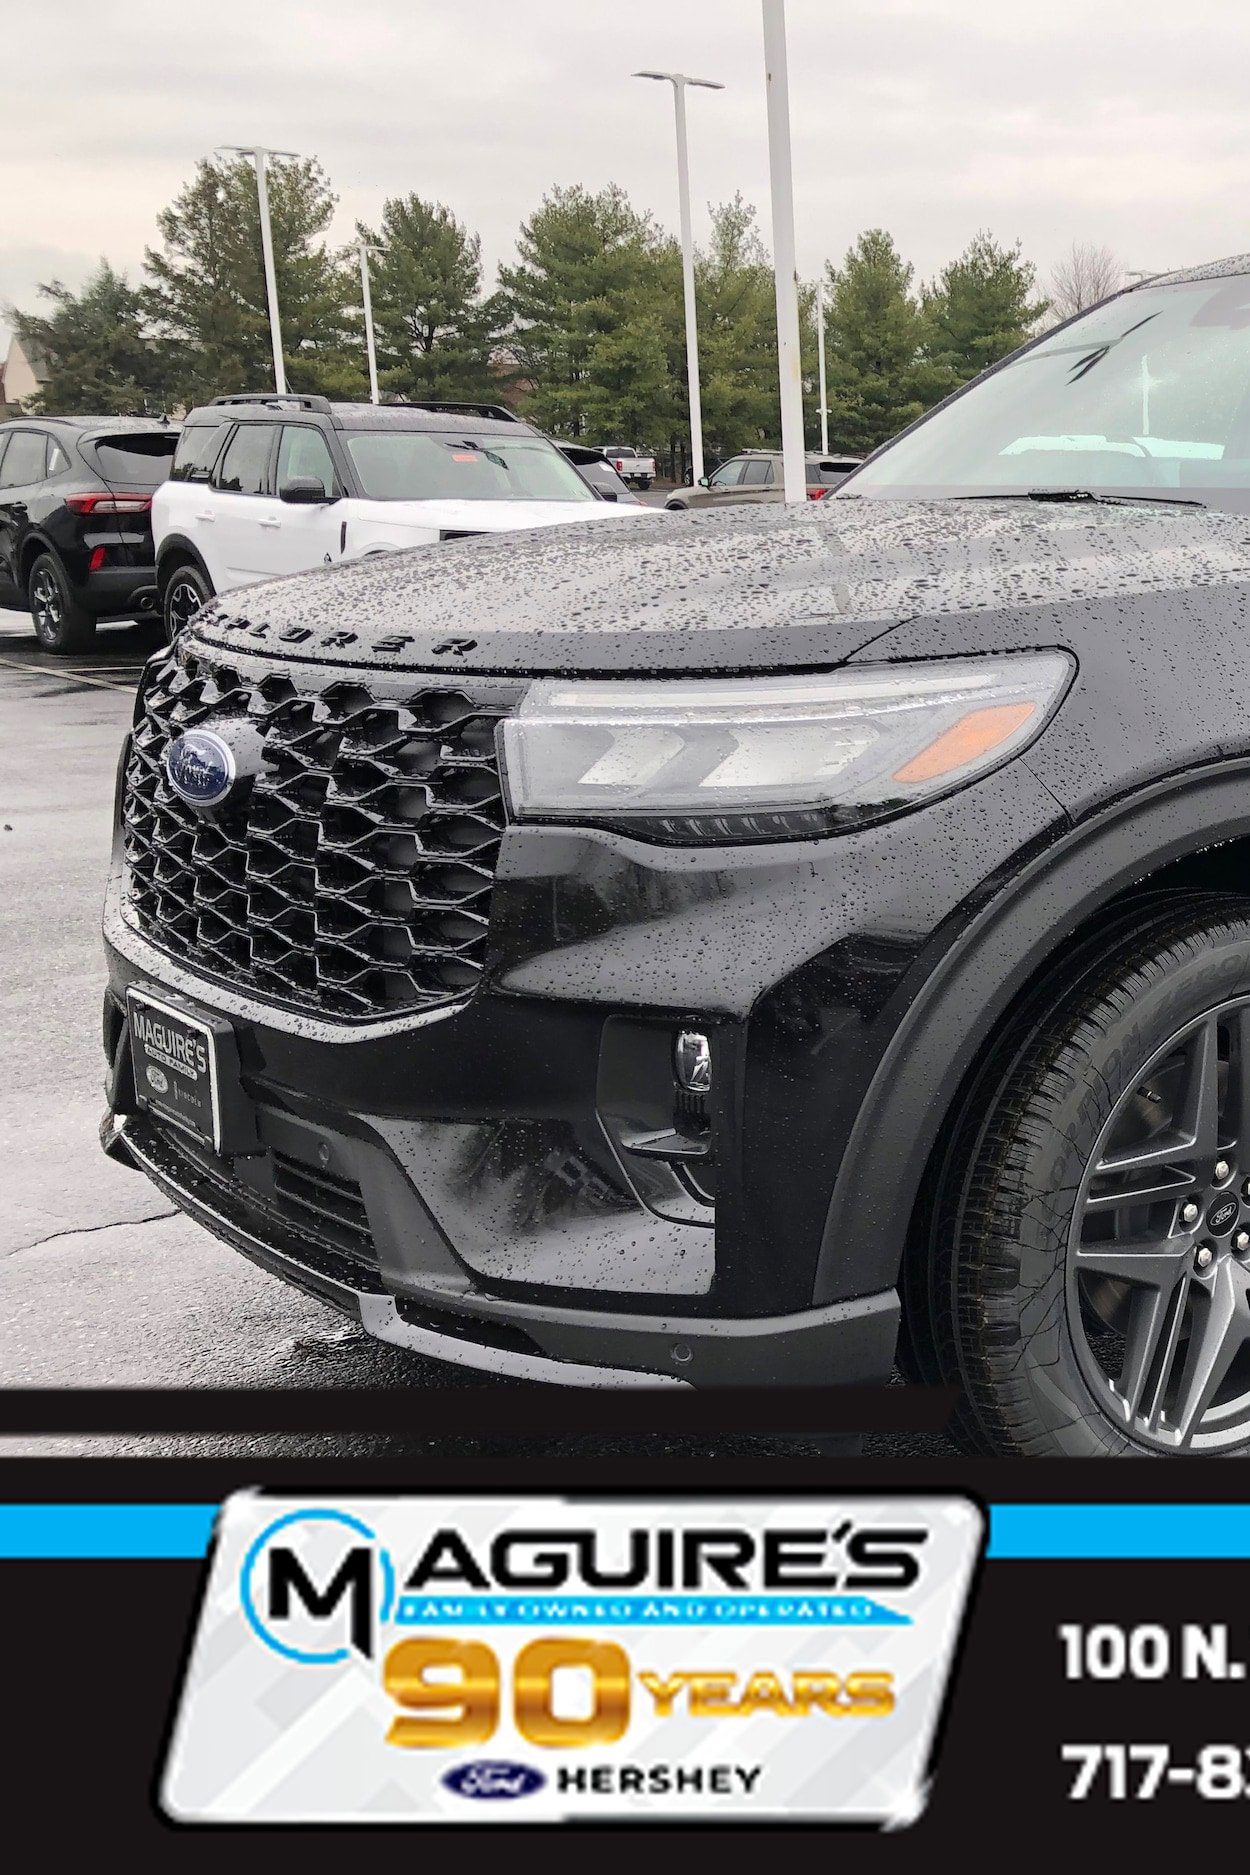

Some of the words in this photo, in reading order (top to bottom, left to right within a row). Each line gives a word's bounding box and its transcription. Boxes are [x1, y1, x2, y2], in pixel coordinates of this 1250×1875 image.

[208, 613, 478, 656] PLORER
[133, 1011, 207, 1074] MAGUIRE'S
[1215, 1205, 1233, 1224] Ford
